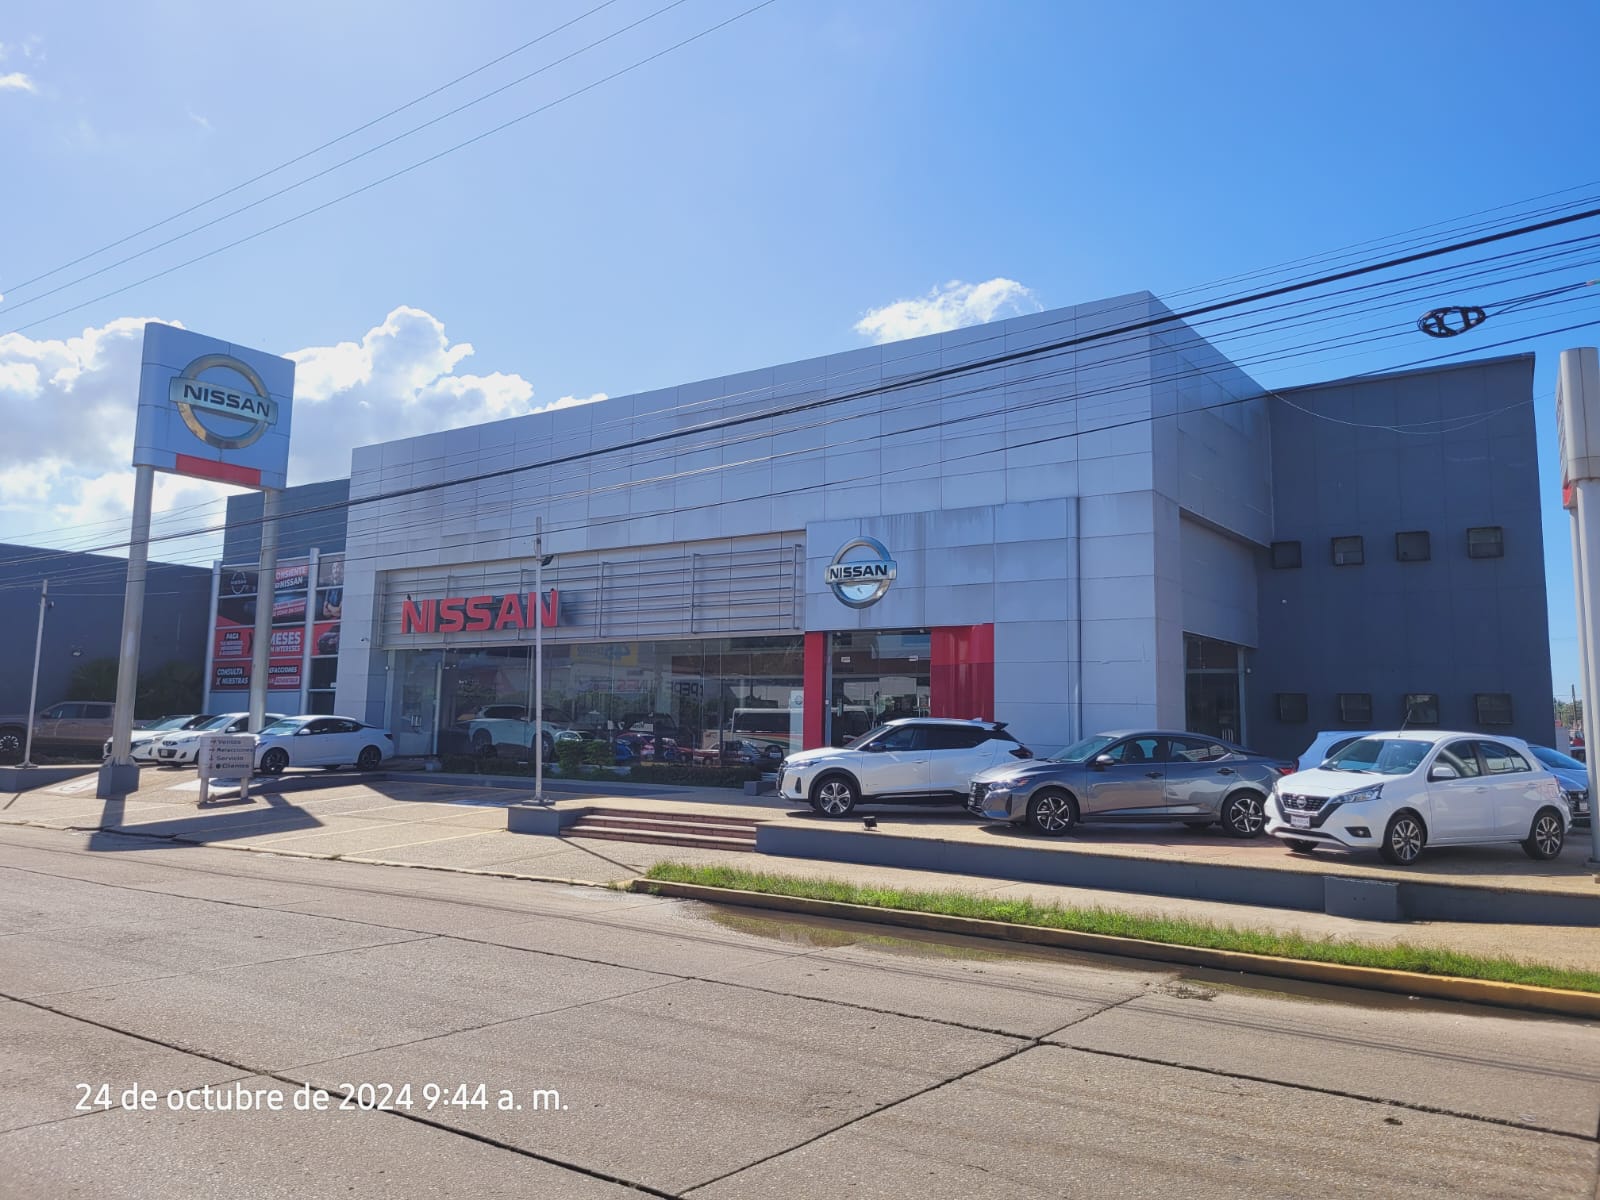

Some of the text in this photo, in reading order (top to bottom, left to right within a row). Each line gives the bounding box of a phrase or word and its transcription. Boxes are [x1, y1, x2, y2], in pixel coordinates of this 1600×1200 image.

[183, 383, 271, 418] NISSAN
[829, 564, 888, 580] NISSAN
[279, 576, 303, 589] NISSAN
[400, 589, 560, 634] NISSAN
[216, 668, 243, 676] CONSULTA
[221, 677, 249, 685] NUESTRAS
